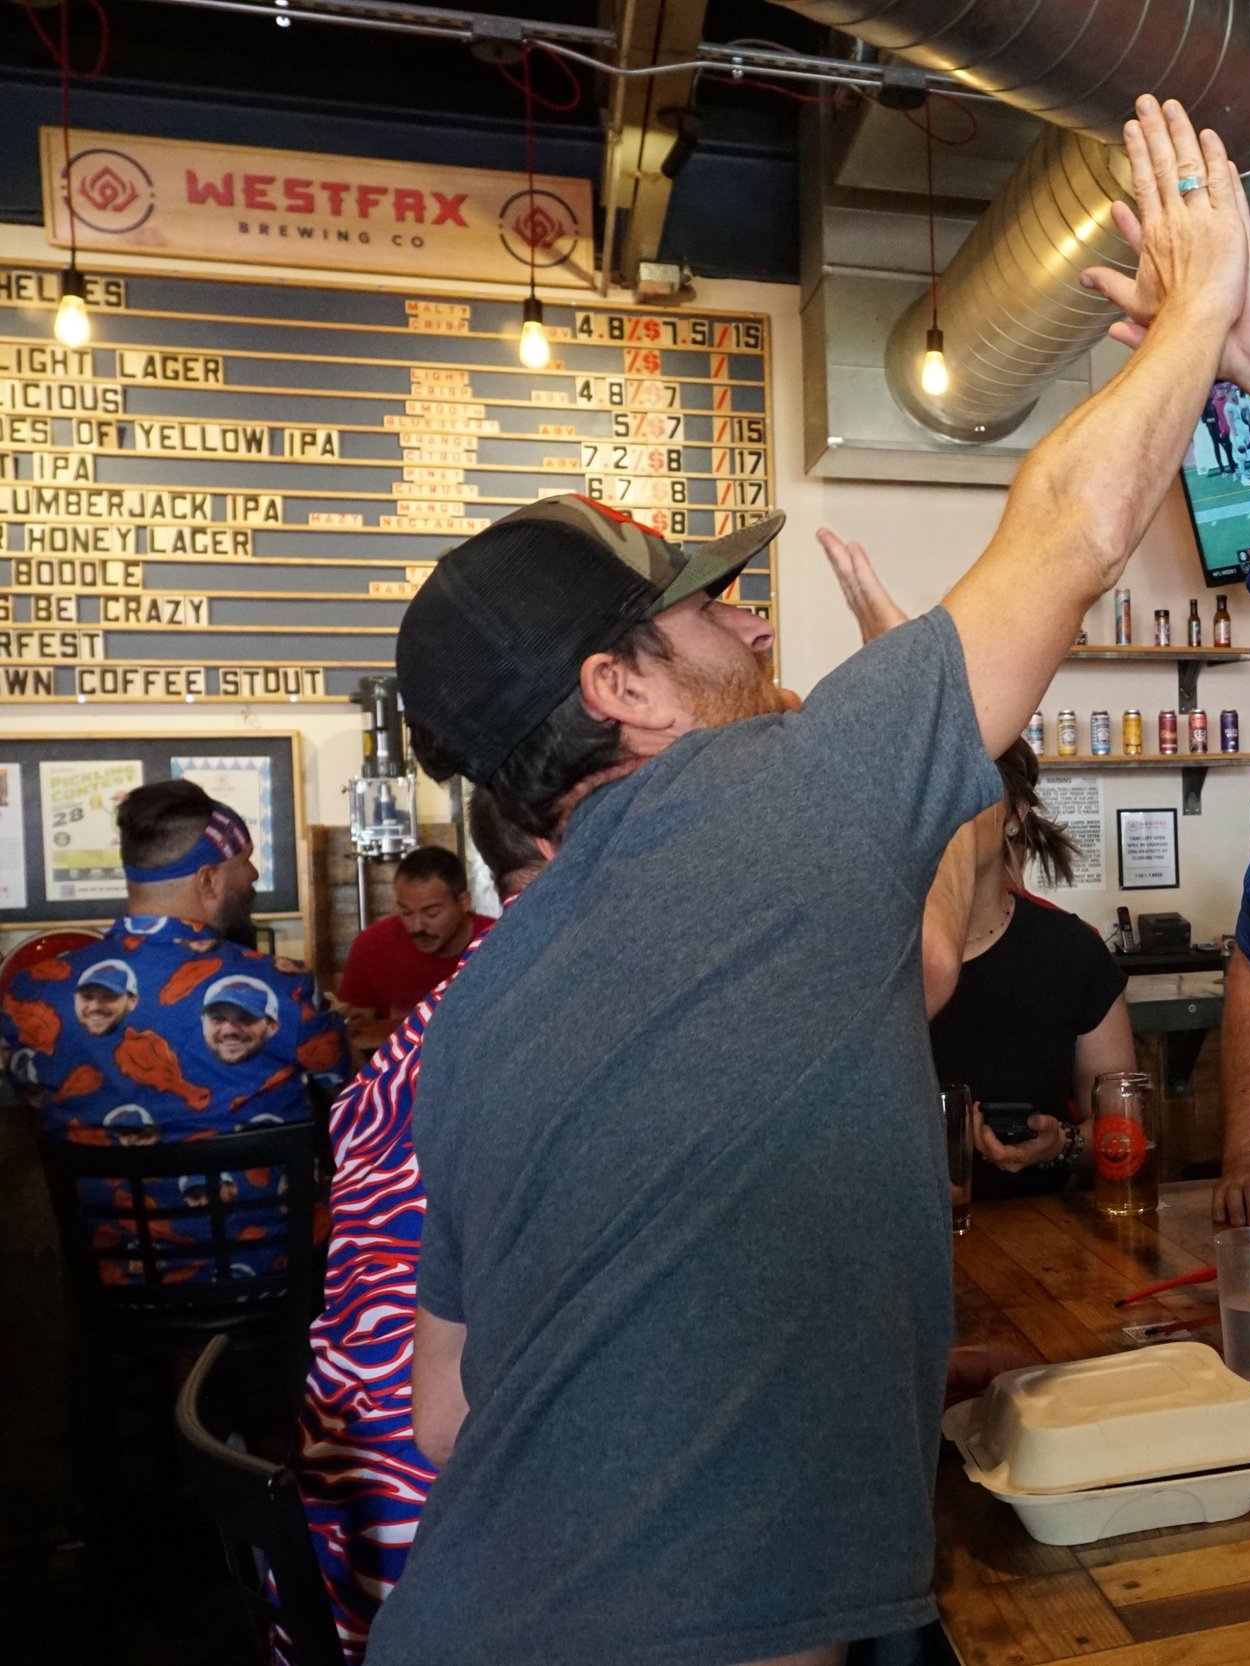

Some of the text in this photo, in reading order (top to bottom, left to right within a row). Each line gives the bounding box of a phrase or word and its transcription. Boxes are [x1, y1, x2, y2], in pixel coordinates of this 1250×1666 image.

[185, 169, 469, 228] WESTFAX
[239, 222, 424, 248] BREWING CO
[407, 303, 468, 315] MALTY
[411, 319, 465, 330] CRISP
[119, 352, 220, 383] LAGER
[76, 420, 116, 447] OF
[137, 423, 265, 454] YELLOW
[288, 432, 335, 457] IPA
[39, 456, 90, 481] IPA
[231, 498, 280, 523] IPA
[310, 513, 361, 525] HAZY
[28, 527, 132, 553] HONEY
[149, 529, 250, 555] LAGER
[33, 598, 74, 622] BE
[102, 599, 204, 625] CRAZY
[79, 668, 203, 695] COFFEE
[221, 669, 321, 695] STOUT
[51, 766, 136, 788] PICKLING
[51, 775, 134, 801] CONTEST
[52, 807, 85, 828] 28
